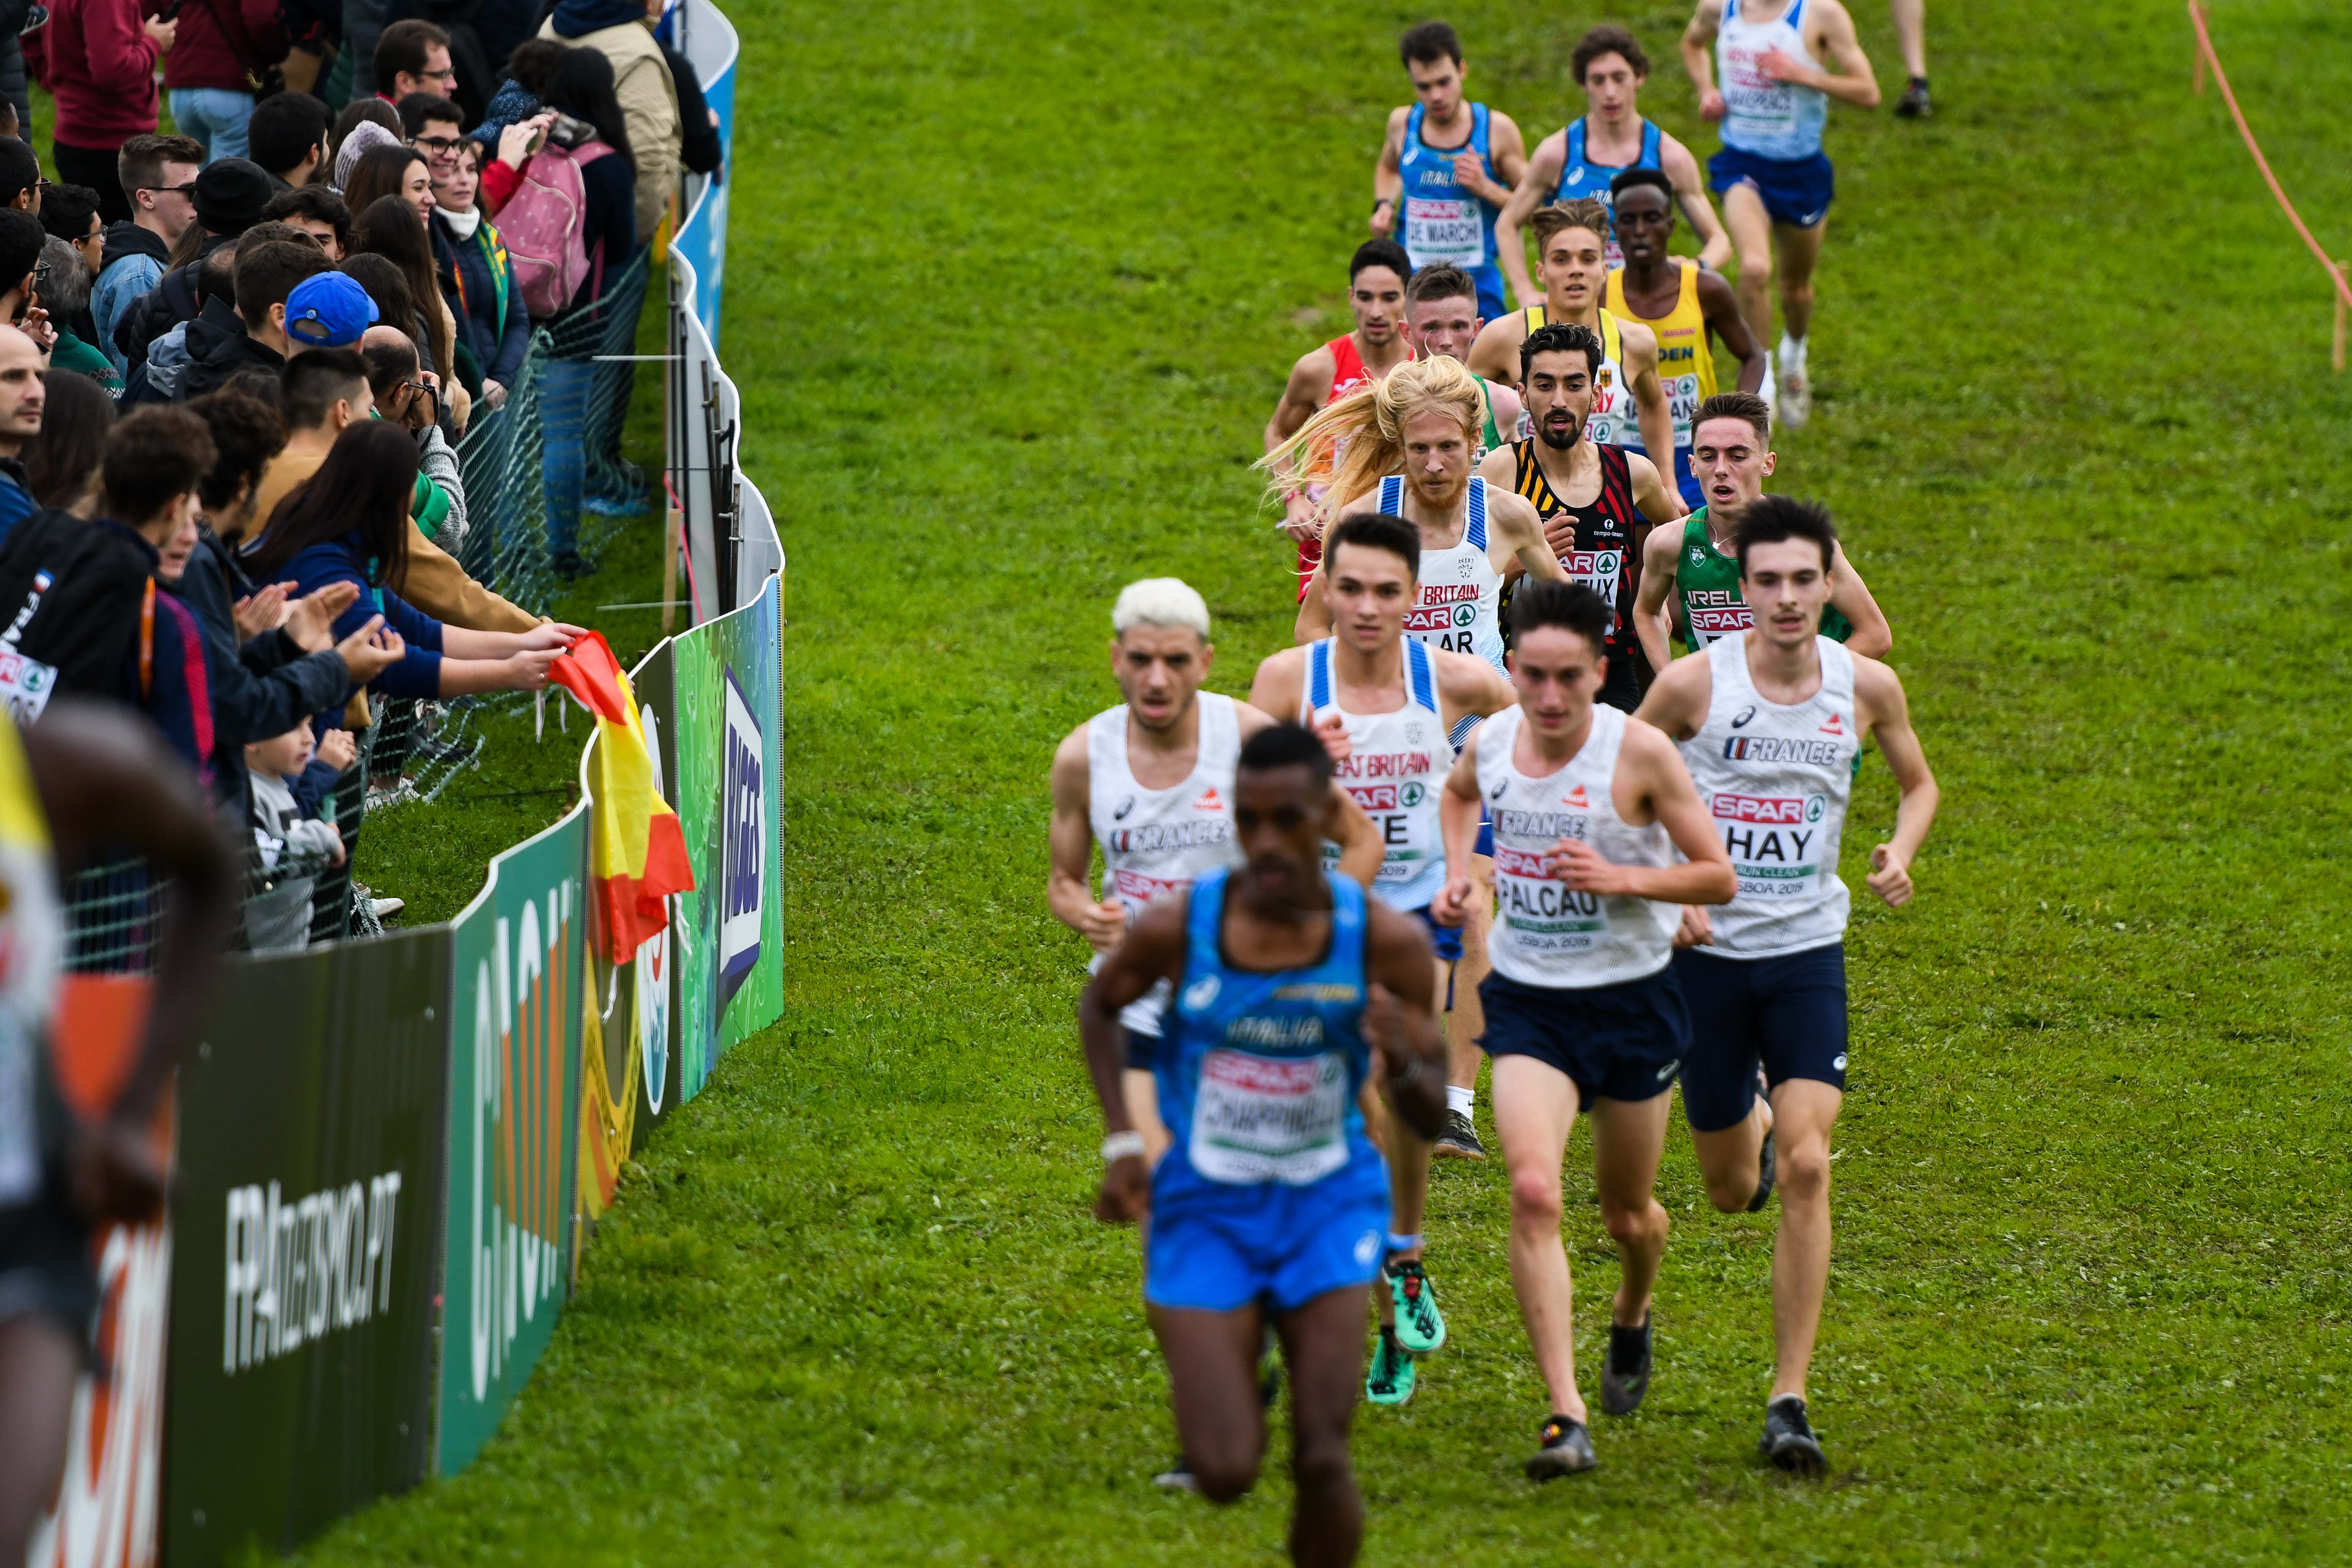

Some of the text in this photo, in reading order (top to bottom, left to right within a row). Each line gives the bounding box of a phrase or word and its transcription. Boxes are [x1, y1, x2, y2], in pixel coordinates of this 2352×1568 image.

[1658, 345, 1693, 362] DEN
[1558, 555, 1592, 571] AR
[1424, 584, 1479, 605] BRITAIN
[1687, 590, 1747, 605] IREL
[1402, 610, 1449, 628] PAR
[1690, 612, 1756, 628] SPAR
[1743, 736, 1838, 765] FRANCE
[1333, 751, 1431, 778] EAT BRITAIN
[1353, 787, 1395, 808] AR
[1714, 796, 1802, 822] SPAR
[1726, 825, 1813, 861] HAY
[1737, 880, 1775, 894] SBOA
